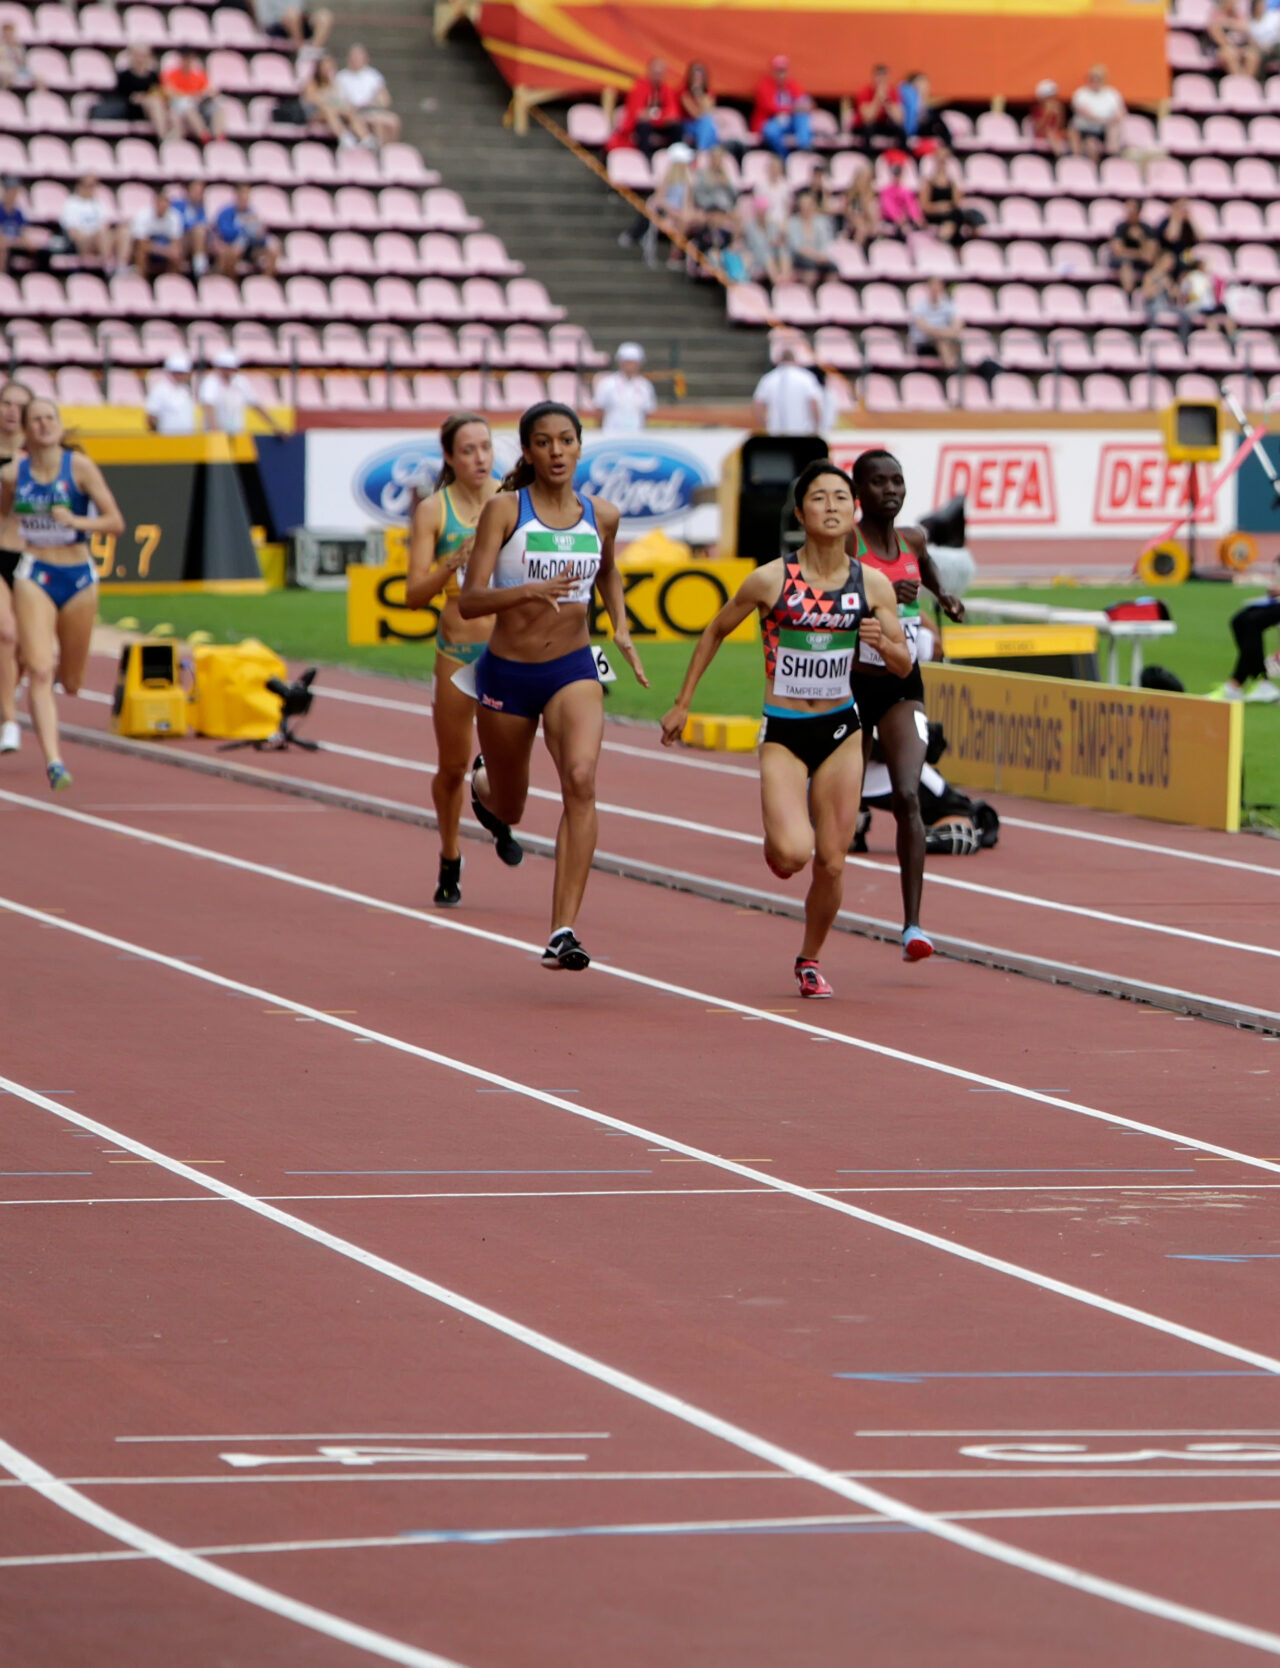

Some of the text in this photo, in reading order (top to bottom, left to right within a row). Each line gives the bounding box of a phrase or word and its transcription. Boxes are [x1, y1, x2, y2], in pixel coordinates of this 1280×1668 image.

[578, 451, 687, 517] Ford
[950, 459, 1042, 510] DEFA
[528, 559, 597, 580] McDONALD
[377, 572, 729, 641] SKO
[792, 611, 855, 628] JAPAN
[597, 651, 609, 675] 6
[781, 655, 848, 679] SHIOMI
[786, 685, 824, 697] TAMPERE
[958, 684, 1063, 792] Championships
[1069, 698, 1134, 784] TAMPERE
[1137, 705, 1171, 789] 2018
[218, 1446, 586, 1468] 4
